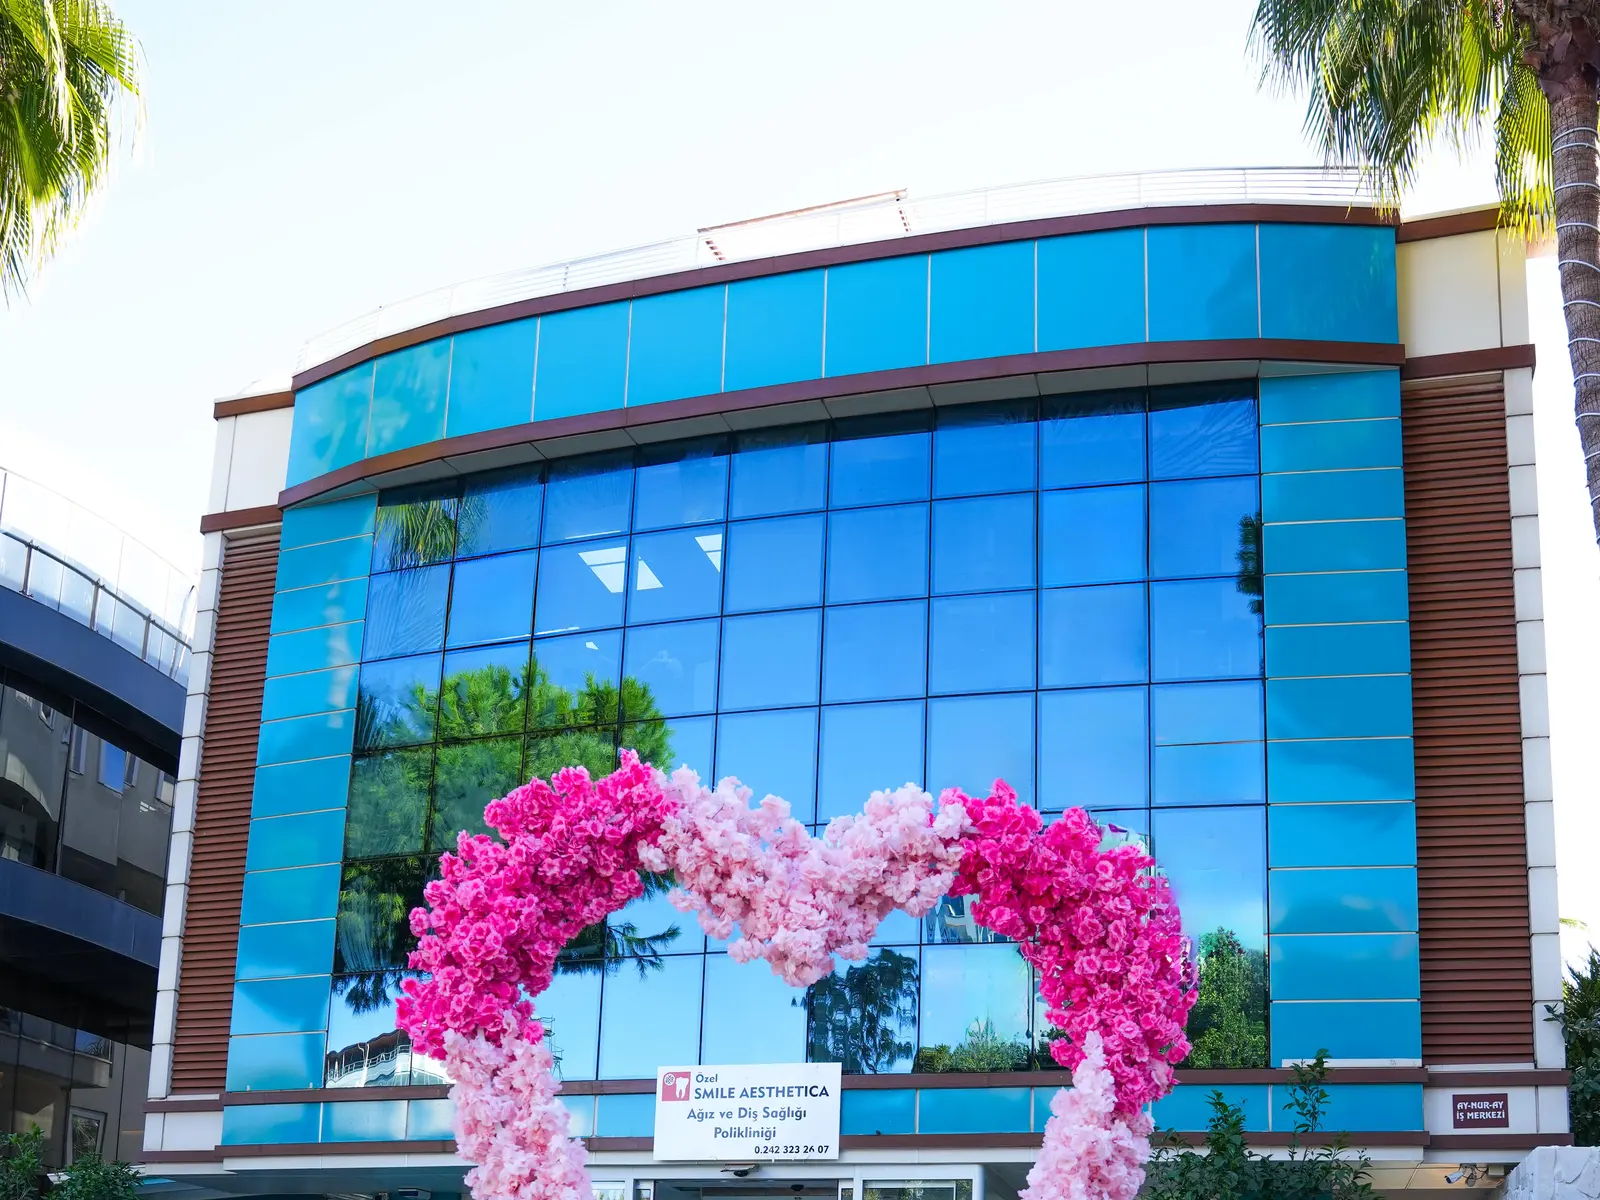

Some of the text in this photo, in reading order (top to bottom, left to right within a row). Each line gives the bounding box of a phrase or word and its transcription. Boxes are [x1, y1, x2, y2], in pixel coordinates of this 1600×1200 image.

[695, 1071, 718, 1083] Özel
[694, 1085, 830, 1100] SMILE AESTHETICA
[1457, 1101, 1504, 1110] AY-NUR-AY
[687, 1106, 807, 1122] Ağız ve Diş Sağlığı
[1456, 1110, 1505, 1122] İŞ MERKEZİ
[714, 1126, 777, 1141] Polikliniği
[754, 1145, 829, 1154] 0.242 323 26 07
